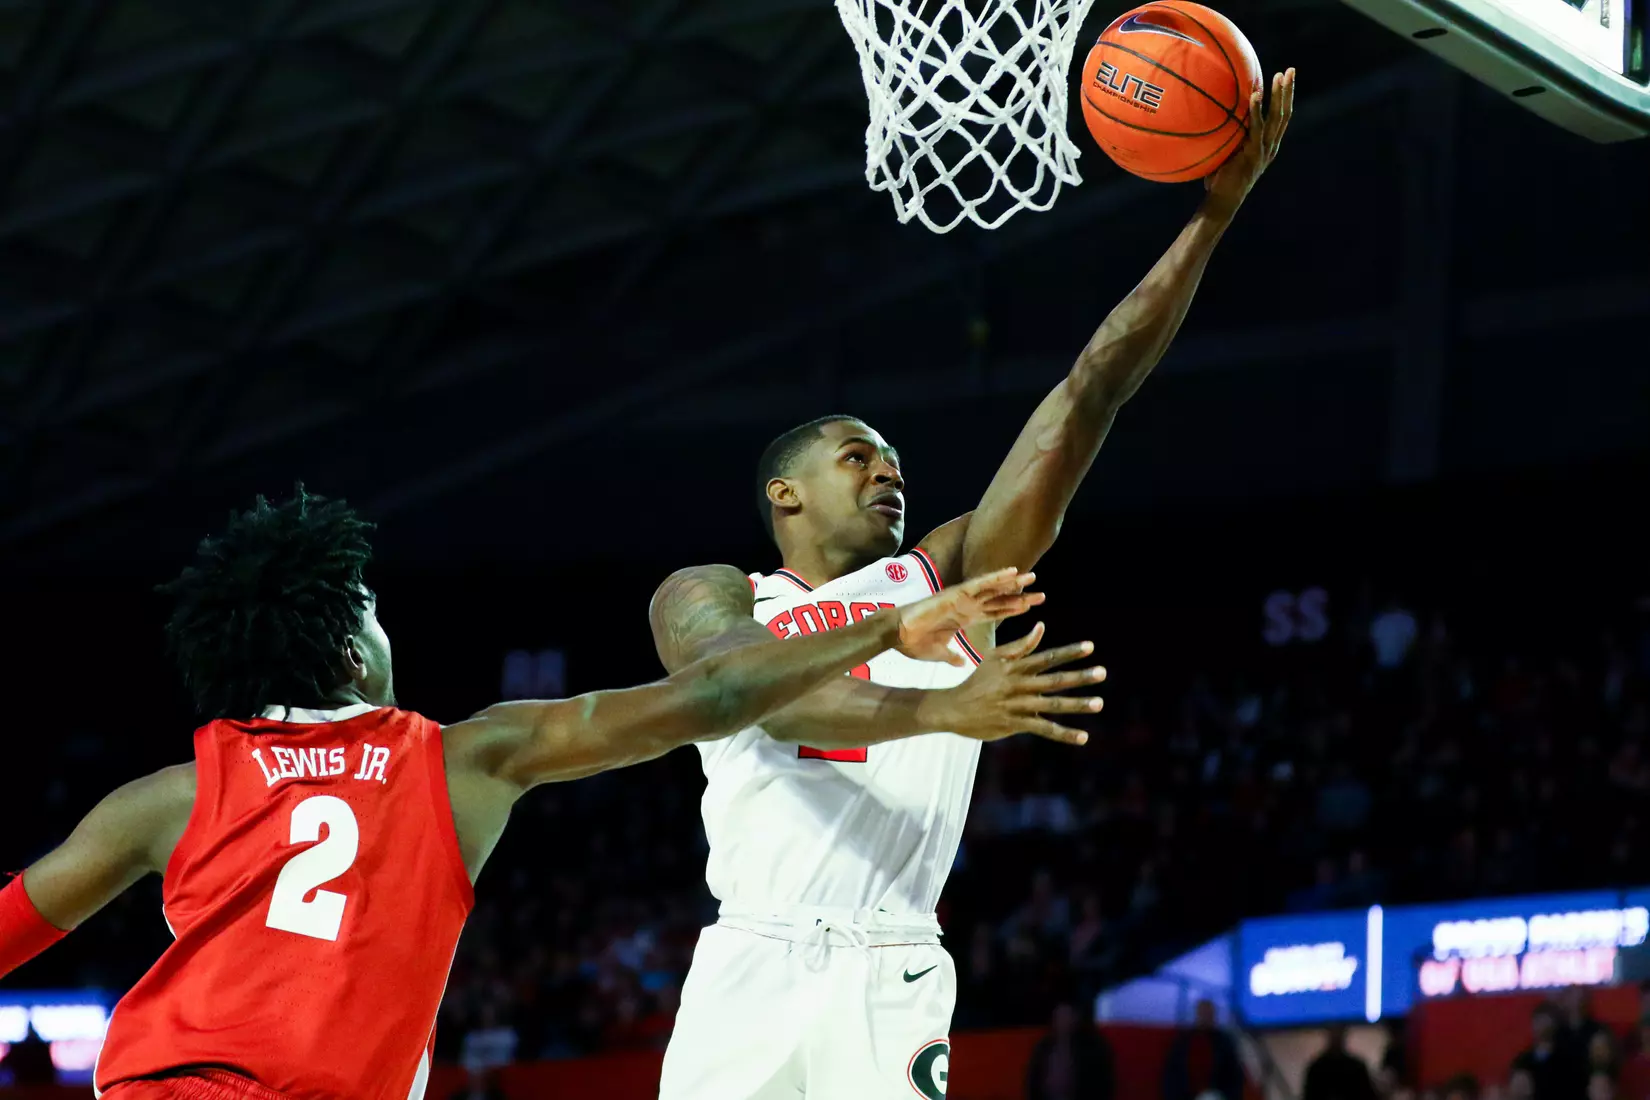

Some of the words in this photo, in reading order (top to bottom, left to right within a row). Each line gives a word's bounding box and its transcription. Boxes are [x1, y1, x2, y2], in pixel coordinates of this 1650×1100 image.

[1092, 81, 1158, 115] CHAMPIONSHIP
[1096, 61, 1165, 109] ELITE
[886, 563, 907, 581] SEC
[251, 746, 345, 788] LEWIS
[353, 743, 390, 785] JR.
[265, 795, 360, 942] 2
